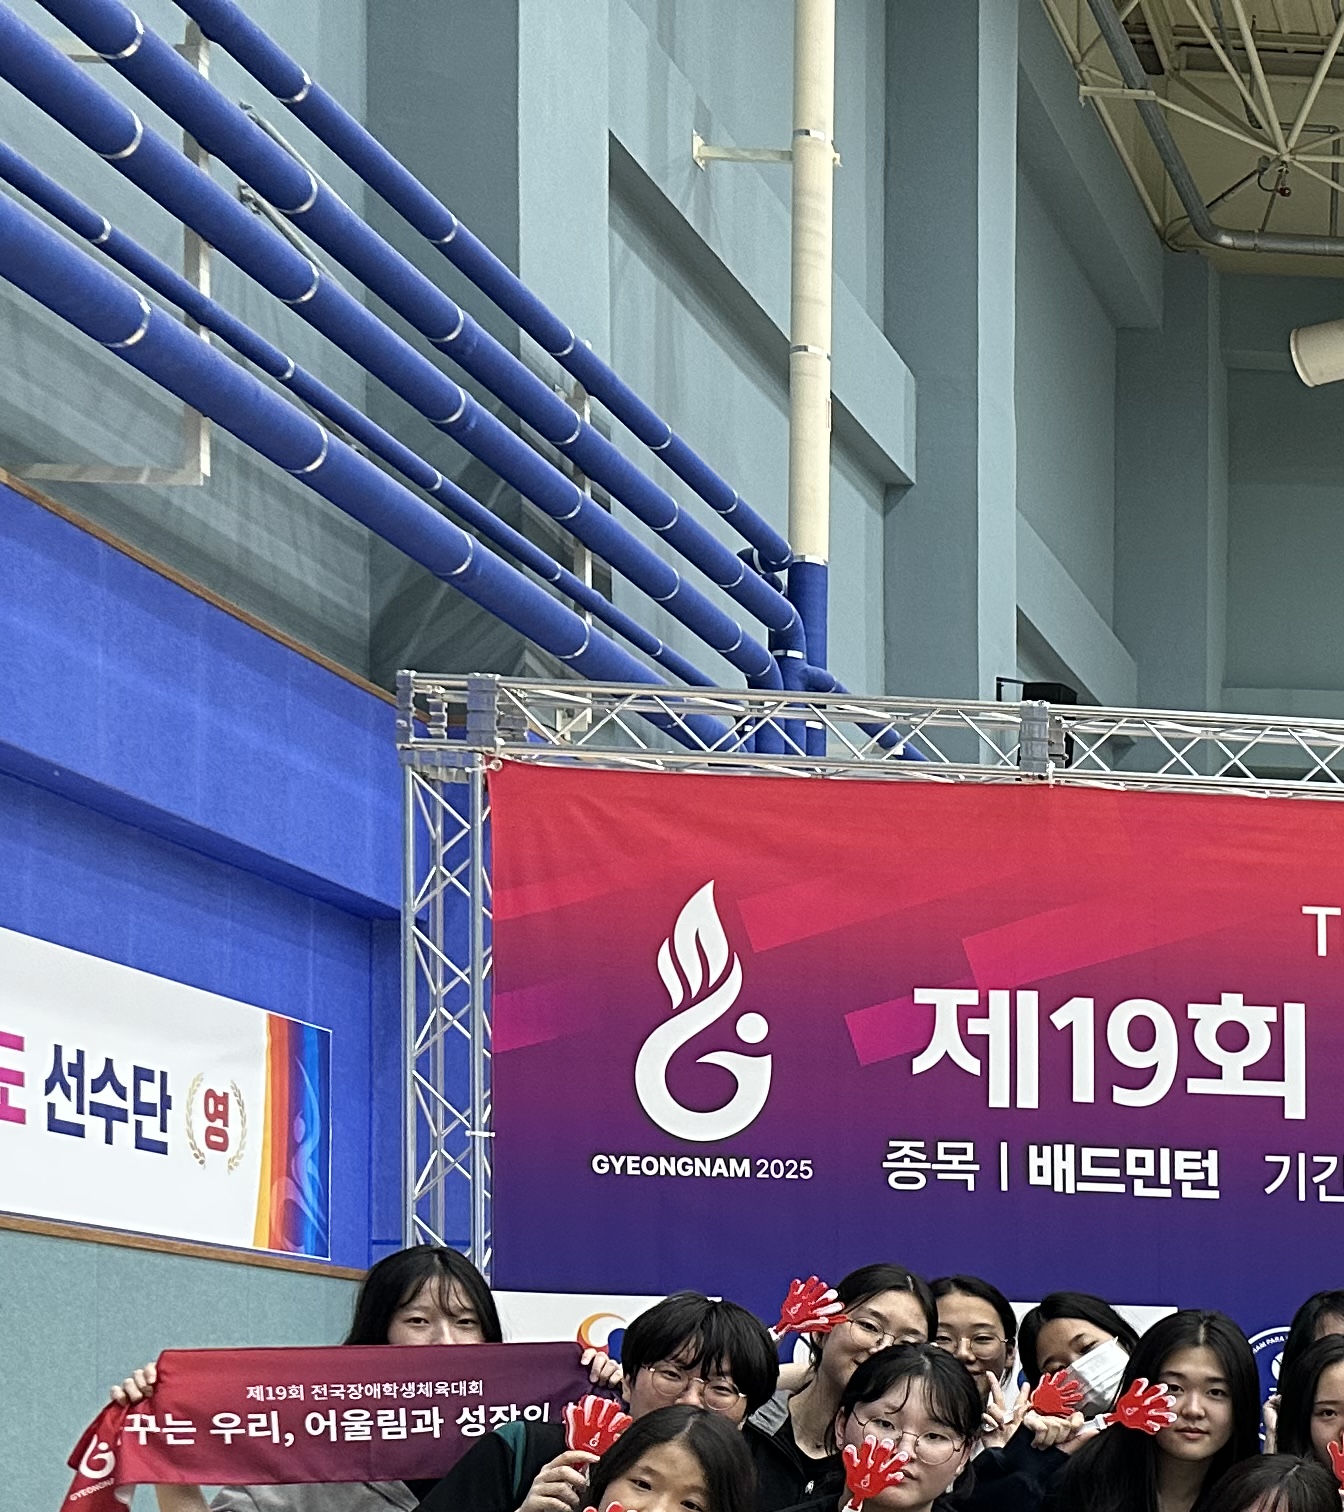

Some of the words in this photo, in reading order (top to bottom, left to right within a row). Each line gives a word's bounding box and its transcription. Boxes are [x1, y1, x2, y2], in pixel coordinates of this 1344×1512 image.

[912, 987, 1307, 1120] 제19회
[44, 1043, 173, 1156] 선수단
[203, 1087, 230, 1153] 영
[591, 1154, 751, 1178] GYEONGNAM
[755, 1159, 814, 1180] 2025
[882, 1139, 981, 1193] 종목
[1028, 1143, 1221, 1200] 배드민턴
[245, 1384, 305, 1402] 제19회
[310, 1379, 484, 1402] 전국장애학생체육대회
[122, 1410, 198, 1447] 꾸는
[209, 1407, 297, 1448] 우리,
[304, 1406, 445, 1442] 어울림과
